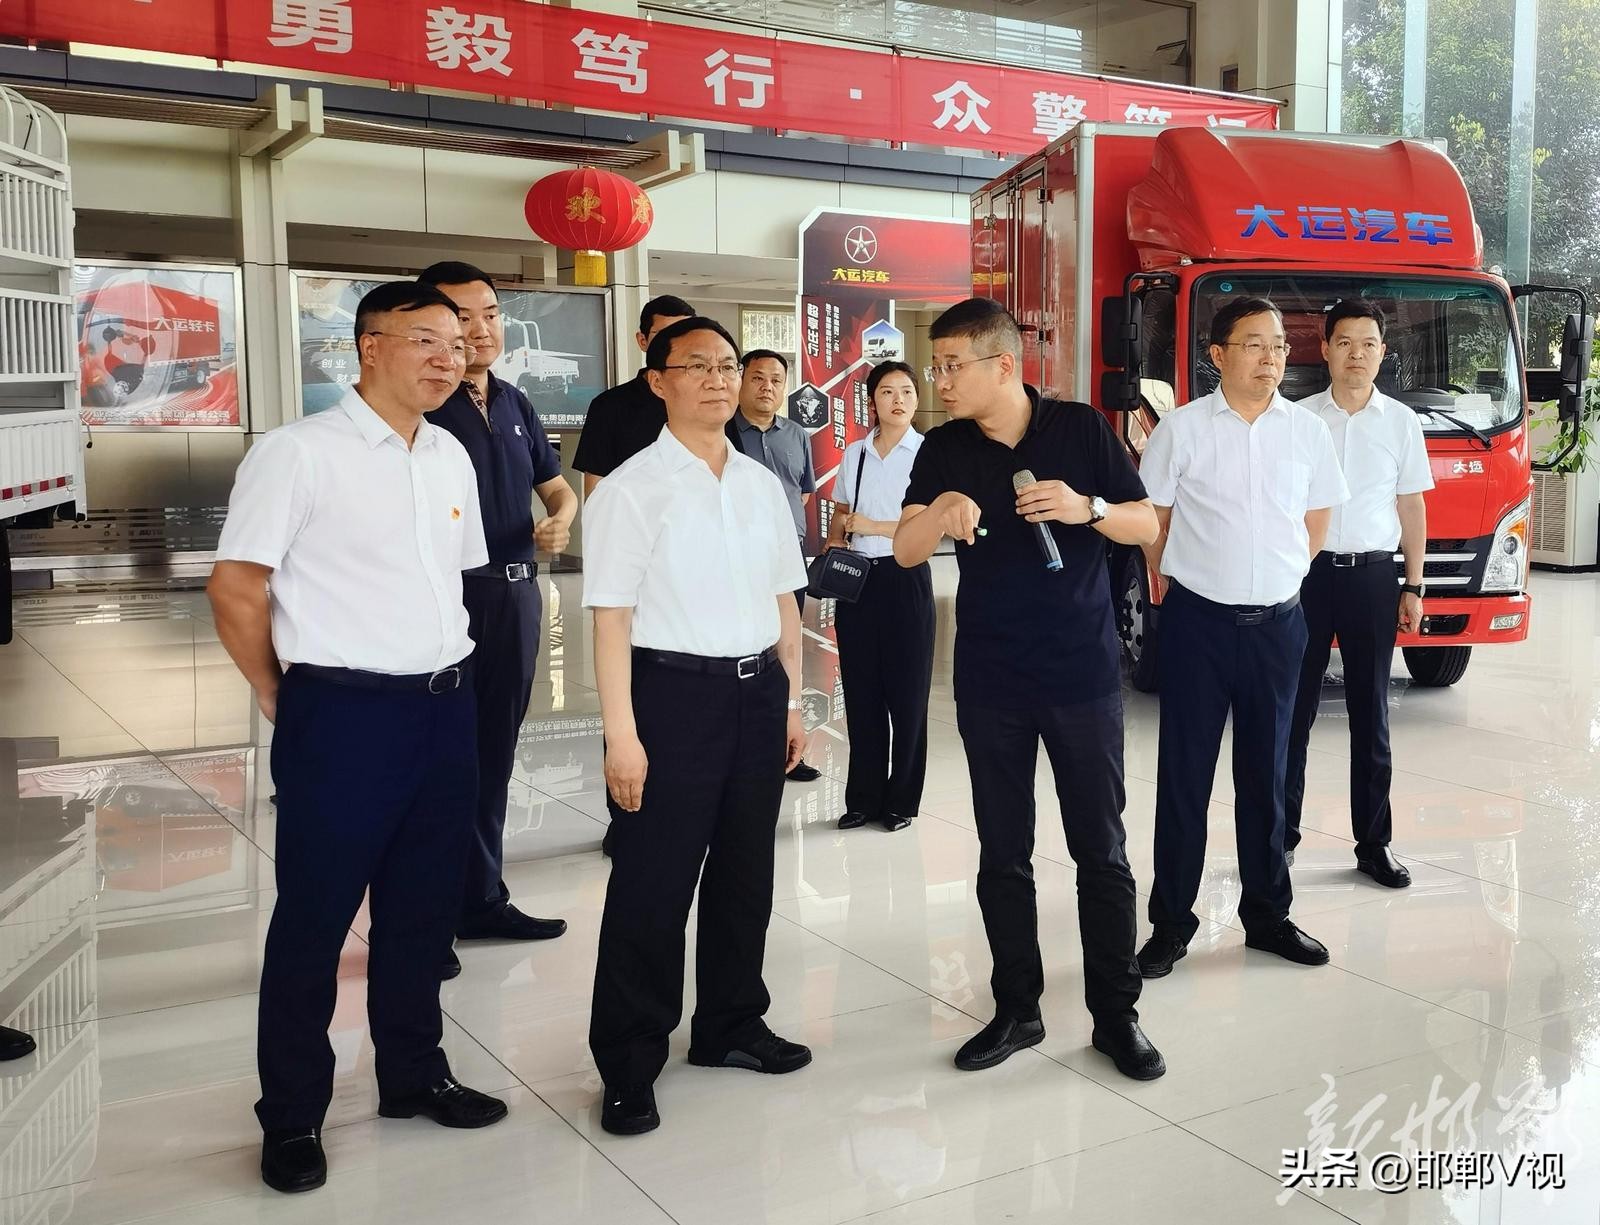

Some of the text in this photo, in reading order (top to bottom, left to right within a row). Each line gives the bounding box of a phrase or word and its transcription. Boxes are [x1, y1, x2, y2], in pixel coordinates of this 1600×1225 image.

[1236, 204, 1453, 245] 大运汽车
[832, 268, 890, 283] 大运汽车
[152, 317, 215, 332] 大运轻卡
[320, 335, 357, 351] 大运
[1453, 460, 1484, 473] 大运
[832, 560, 862, 578] MIPRO
